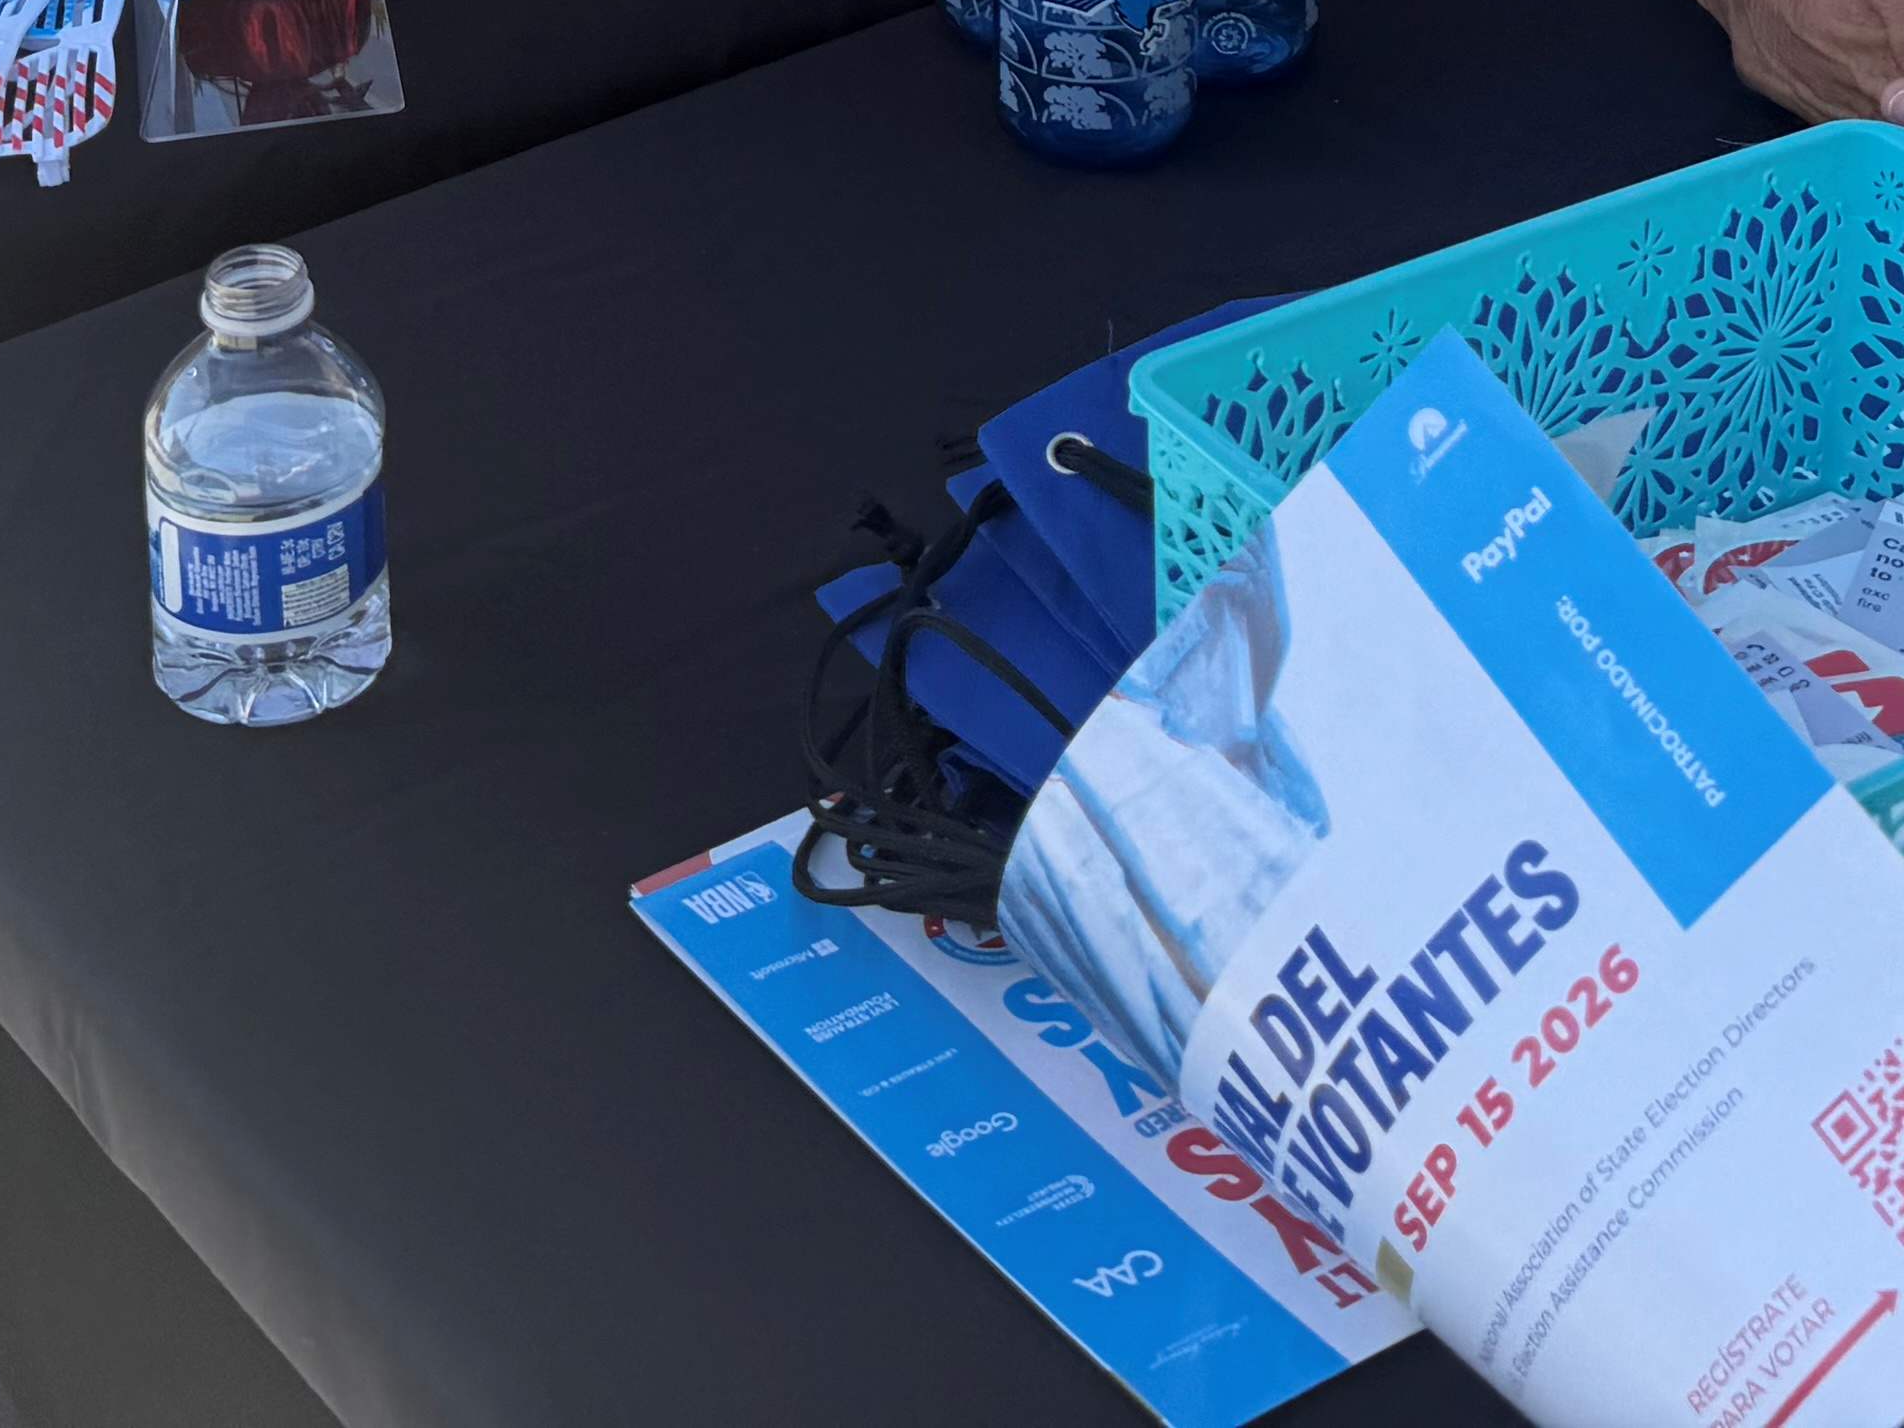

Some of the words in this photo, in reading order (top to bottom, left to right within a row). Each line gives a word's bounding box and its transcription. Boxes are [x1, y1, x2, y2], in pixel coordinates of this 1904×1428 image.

[1461, 486, 1552, 584] PayPal
[1556, 595, 1602, 653] POR:
[1594, 648, 1727, 808] PATROCINADO
[681, 879, 758, 925] NBA
[750, 948, 817, 980] Microsoft
[869, 997, 900, 1019] LEVI
[1249, 923, 1380, 1090] DEL
[1288, 839, 1580, 1210] VOTANTES
[925, 1110, 1019, 1160] Google
[1394, 1142, 1458, 1252] SEP
[1456, 1076, 1516, 1149] 15
[1511, 943, 1640, 1090] 2026
[1502, 1204, 1580, 1311] Association
[1580, 1174, 1601, 1207] of
[1597, 1125, 1647, 1188] State
[1644, 1045, 1725, 1130] Election
[1722, 955, 1817, 1048] Directors
[1550, 1204, 1631, 1313] Assistance
[1627, 1084, 1746, 1210] Commission
[1072, 1249, 1163, 1298] CAA
[1758, 1297, 1836, 1379] VOTAR
